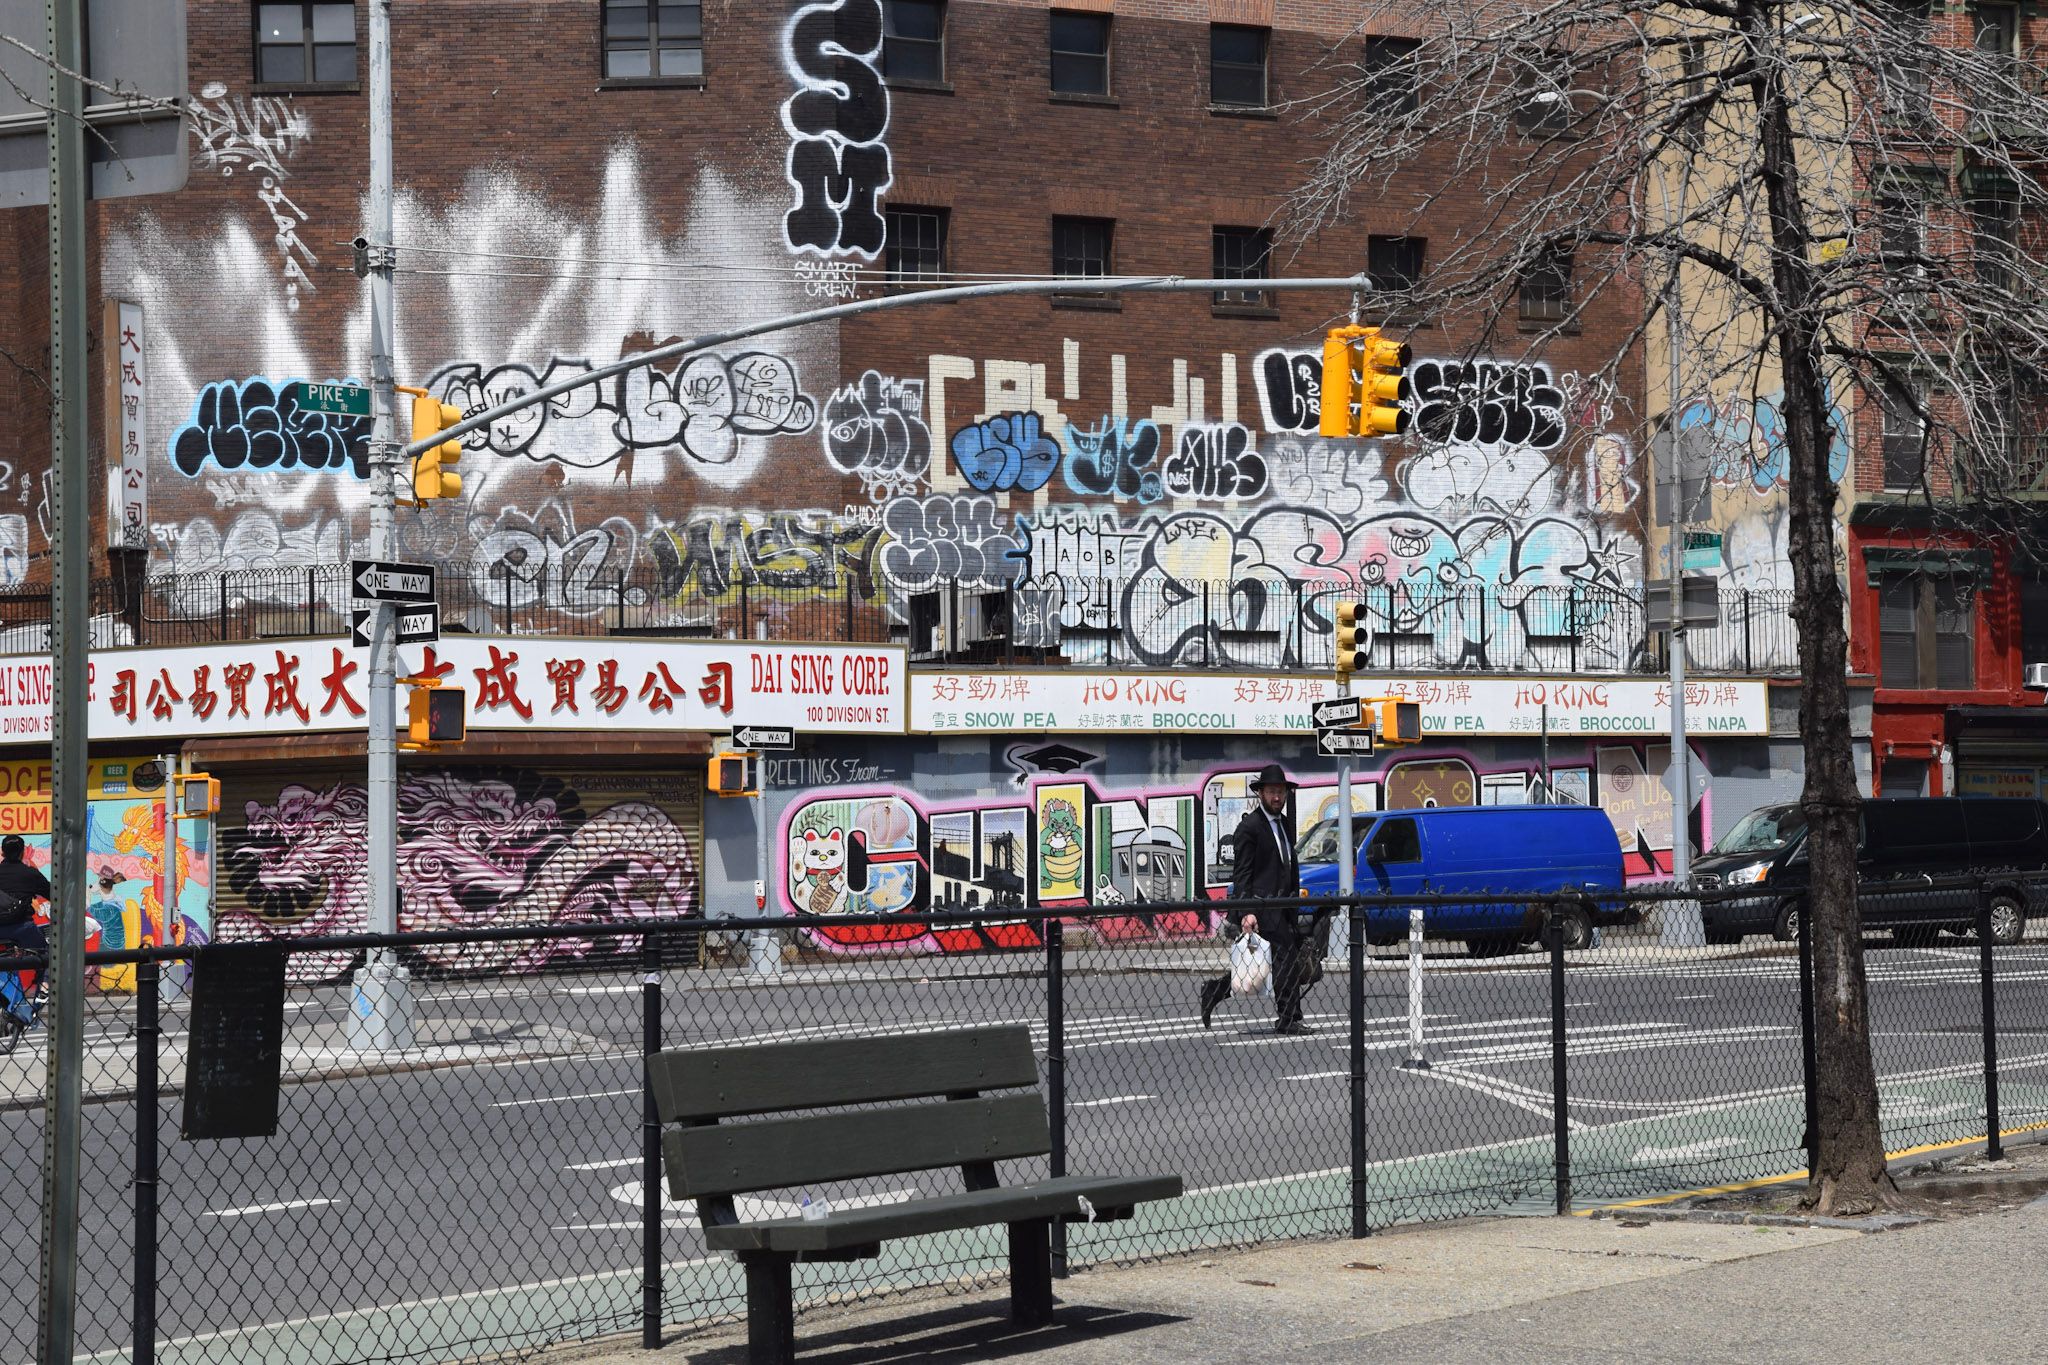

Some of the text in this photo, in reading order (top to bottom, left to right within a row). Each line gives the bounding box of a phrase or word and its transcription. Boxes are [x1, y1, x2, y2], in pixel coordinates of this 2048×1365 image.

[795, 260, 863, 280] SMART
[308, 385, 359, 402] PIKE ST
[120, 325, 143, 528] 大成貿易公司
[365, 573, 425, 591] ONE WAY
[402, 616, 427, 632] WAY
[751, 653, 890, 696] DAI SING CORP.
[18, 663, 52, 706] SING
[932, 676, 1031, 701] 好勁牌
[1083, 678, 1187, 706] HO KING
[1514, 683, 1609, 710] HO KING
[807, 706, 890, 724] 100 DIVISION ST.
[964, 712, 1057, 728] SNOW PEA
[1152, 712, 1235, 728] BROCCOLI
[1284, 714, 1313, 729] NAP
[1320, 706, 1354, 720] ONE WAY
[4, 718, 40, 734] DIVISION
[1455, 716, 1485, 730] PEA
[1580, 717, 1656, 731] BROCCOLI
[1707, 717, 1747, 731] NAPA
[742, 732, 786, 743] ONE WAY
[1326, 736, 1366, 748] ONE WAY
[764, 758, 841, 786] REETINGS
[103, 783, 126, 792] COFFEE
[1641, 777, 1673, 805] Wa
[1, 805, 48, 831] SUM
